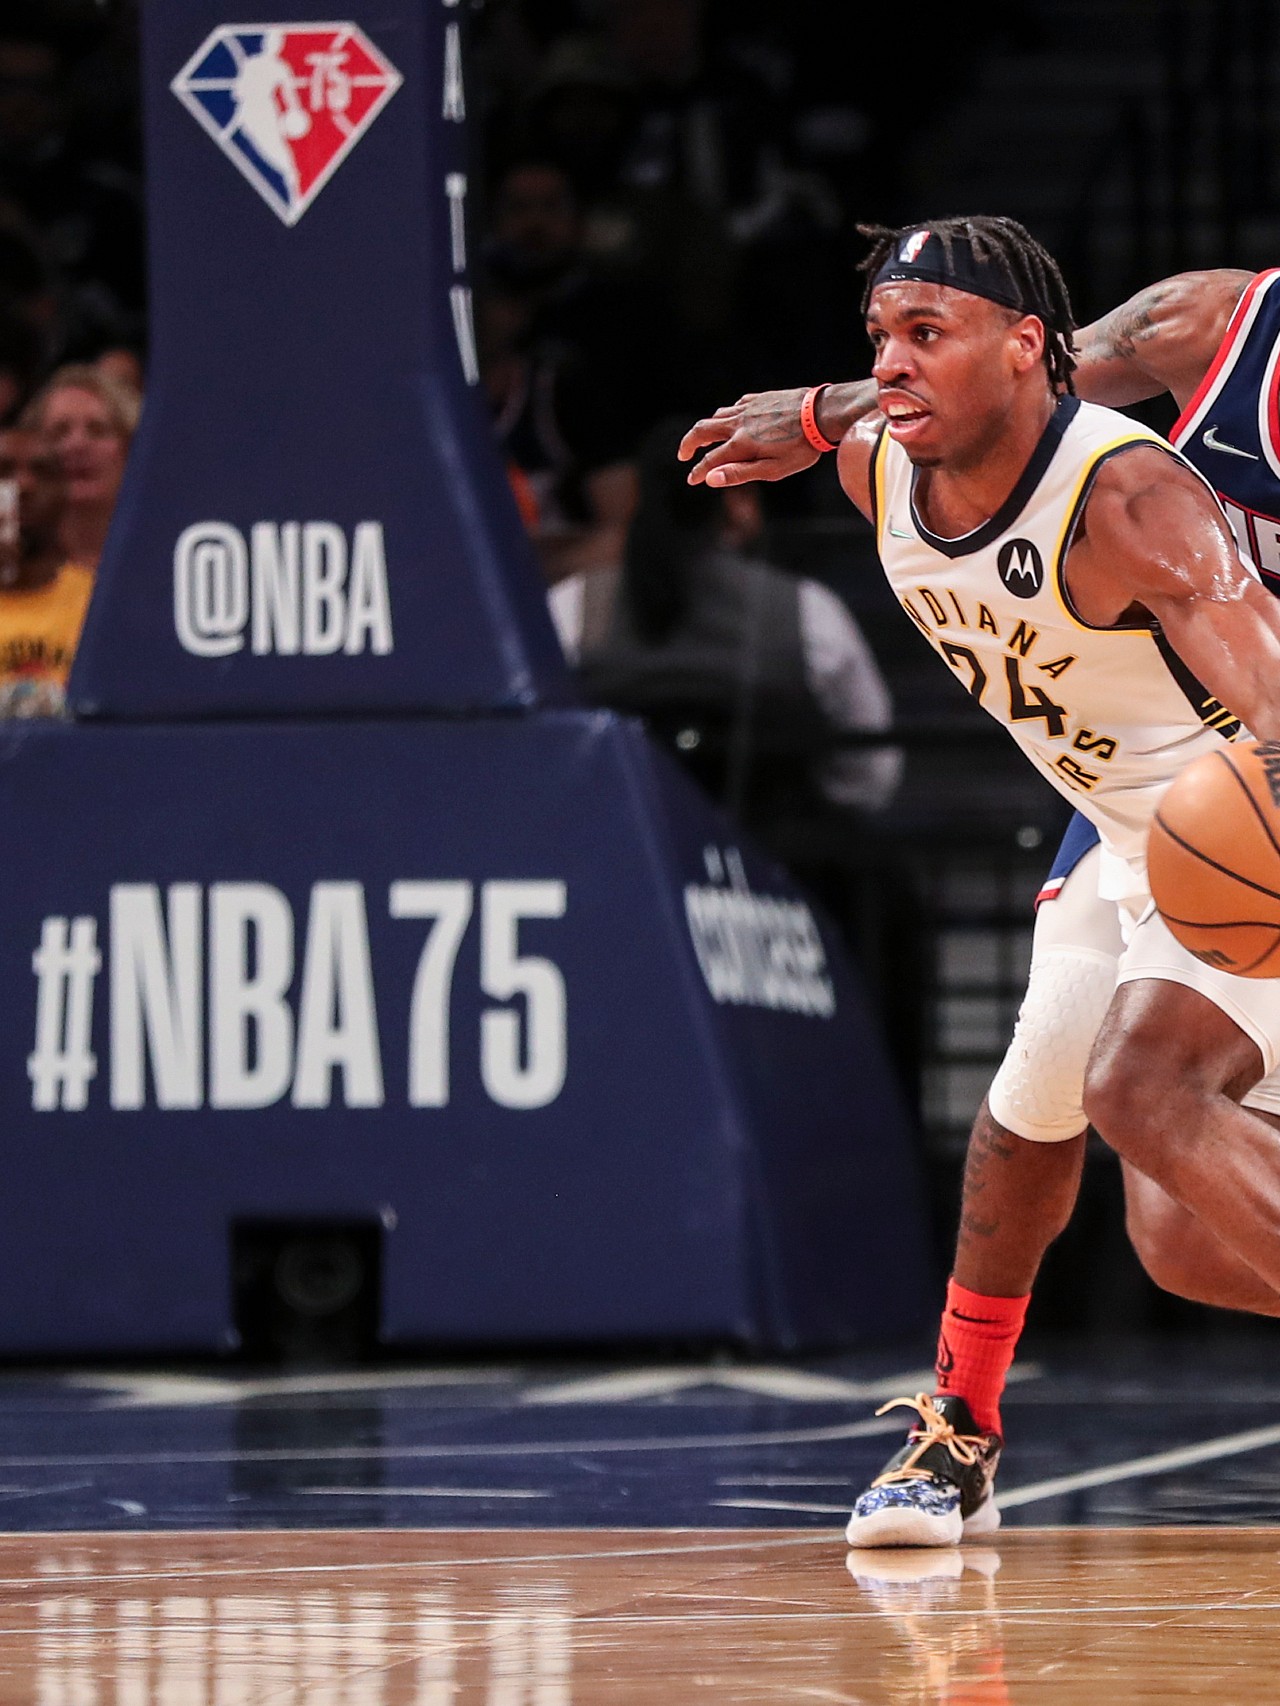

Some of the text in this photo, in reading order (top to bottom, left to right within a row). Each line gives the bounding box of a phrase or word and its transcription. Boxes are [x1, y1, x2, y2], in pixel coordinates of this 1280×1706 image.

[304, 52, 351, 112] 75
[173, 520, 394, 656] @NBA
[902, 585, 1078, 680] NDIANA
[938, 638, 1068, 738] 24
[28, 880, 568, 1111] #NBA75
